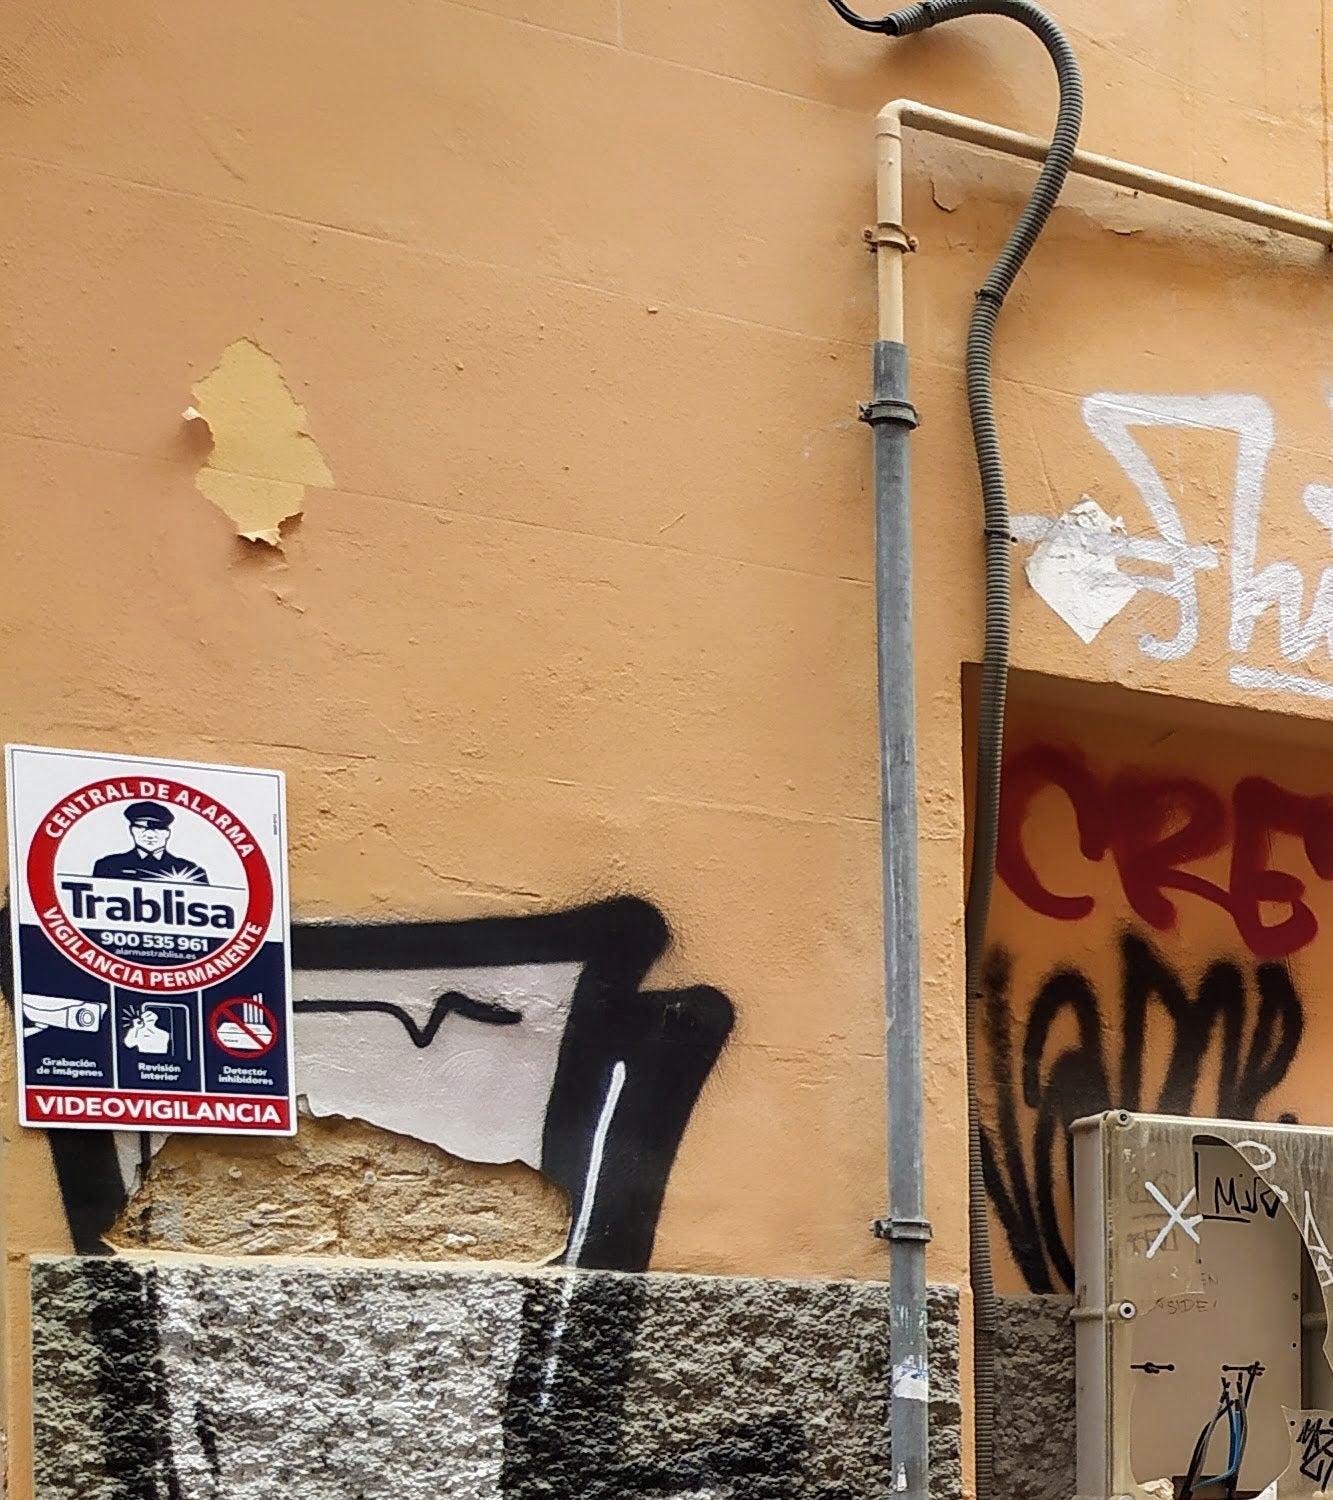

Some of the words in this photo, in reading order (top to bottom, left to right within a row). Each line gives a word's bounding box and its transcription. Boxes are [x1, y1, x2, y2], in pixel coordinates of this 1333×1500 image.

[45, 782, 135, 839] CENTRAL
[138, 780, 170, 800] DE
[175, 789, 255, 858] ALARMA
[60, 881, 236, 930] Trablisa
[42, 905, 145, 986] VIGILANCIA
[150, 920, 263, 988] PERMANENTE
[100, 931, 140, 948] 900
[142, 933, 175, 949] 535
[177, 937, 209, 952] 961
[114, 947, 197, 960] alarmastrablisa.es
[42, 1056, 97, 1068] Grabación
[137, 1062, 181, 1073] Revisión
[36, 1066, 50, 1075] de
[52, 1066, 104, 1078] imágenes
[140, 1071, 179, 1082] interior
[222, 1065, 268, 1077] Detector
[218, 1074, 274, 1086] inhibidores
[35, 1095, 282, 1124] VIDEOVIGILANCIA
